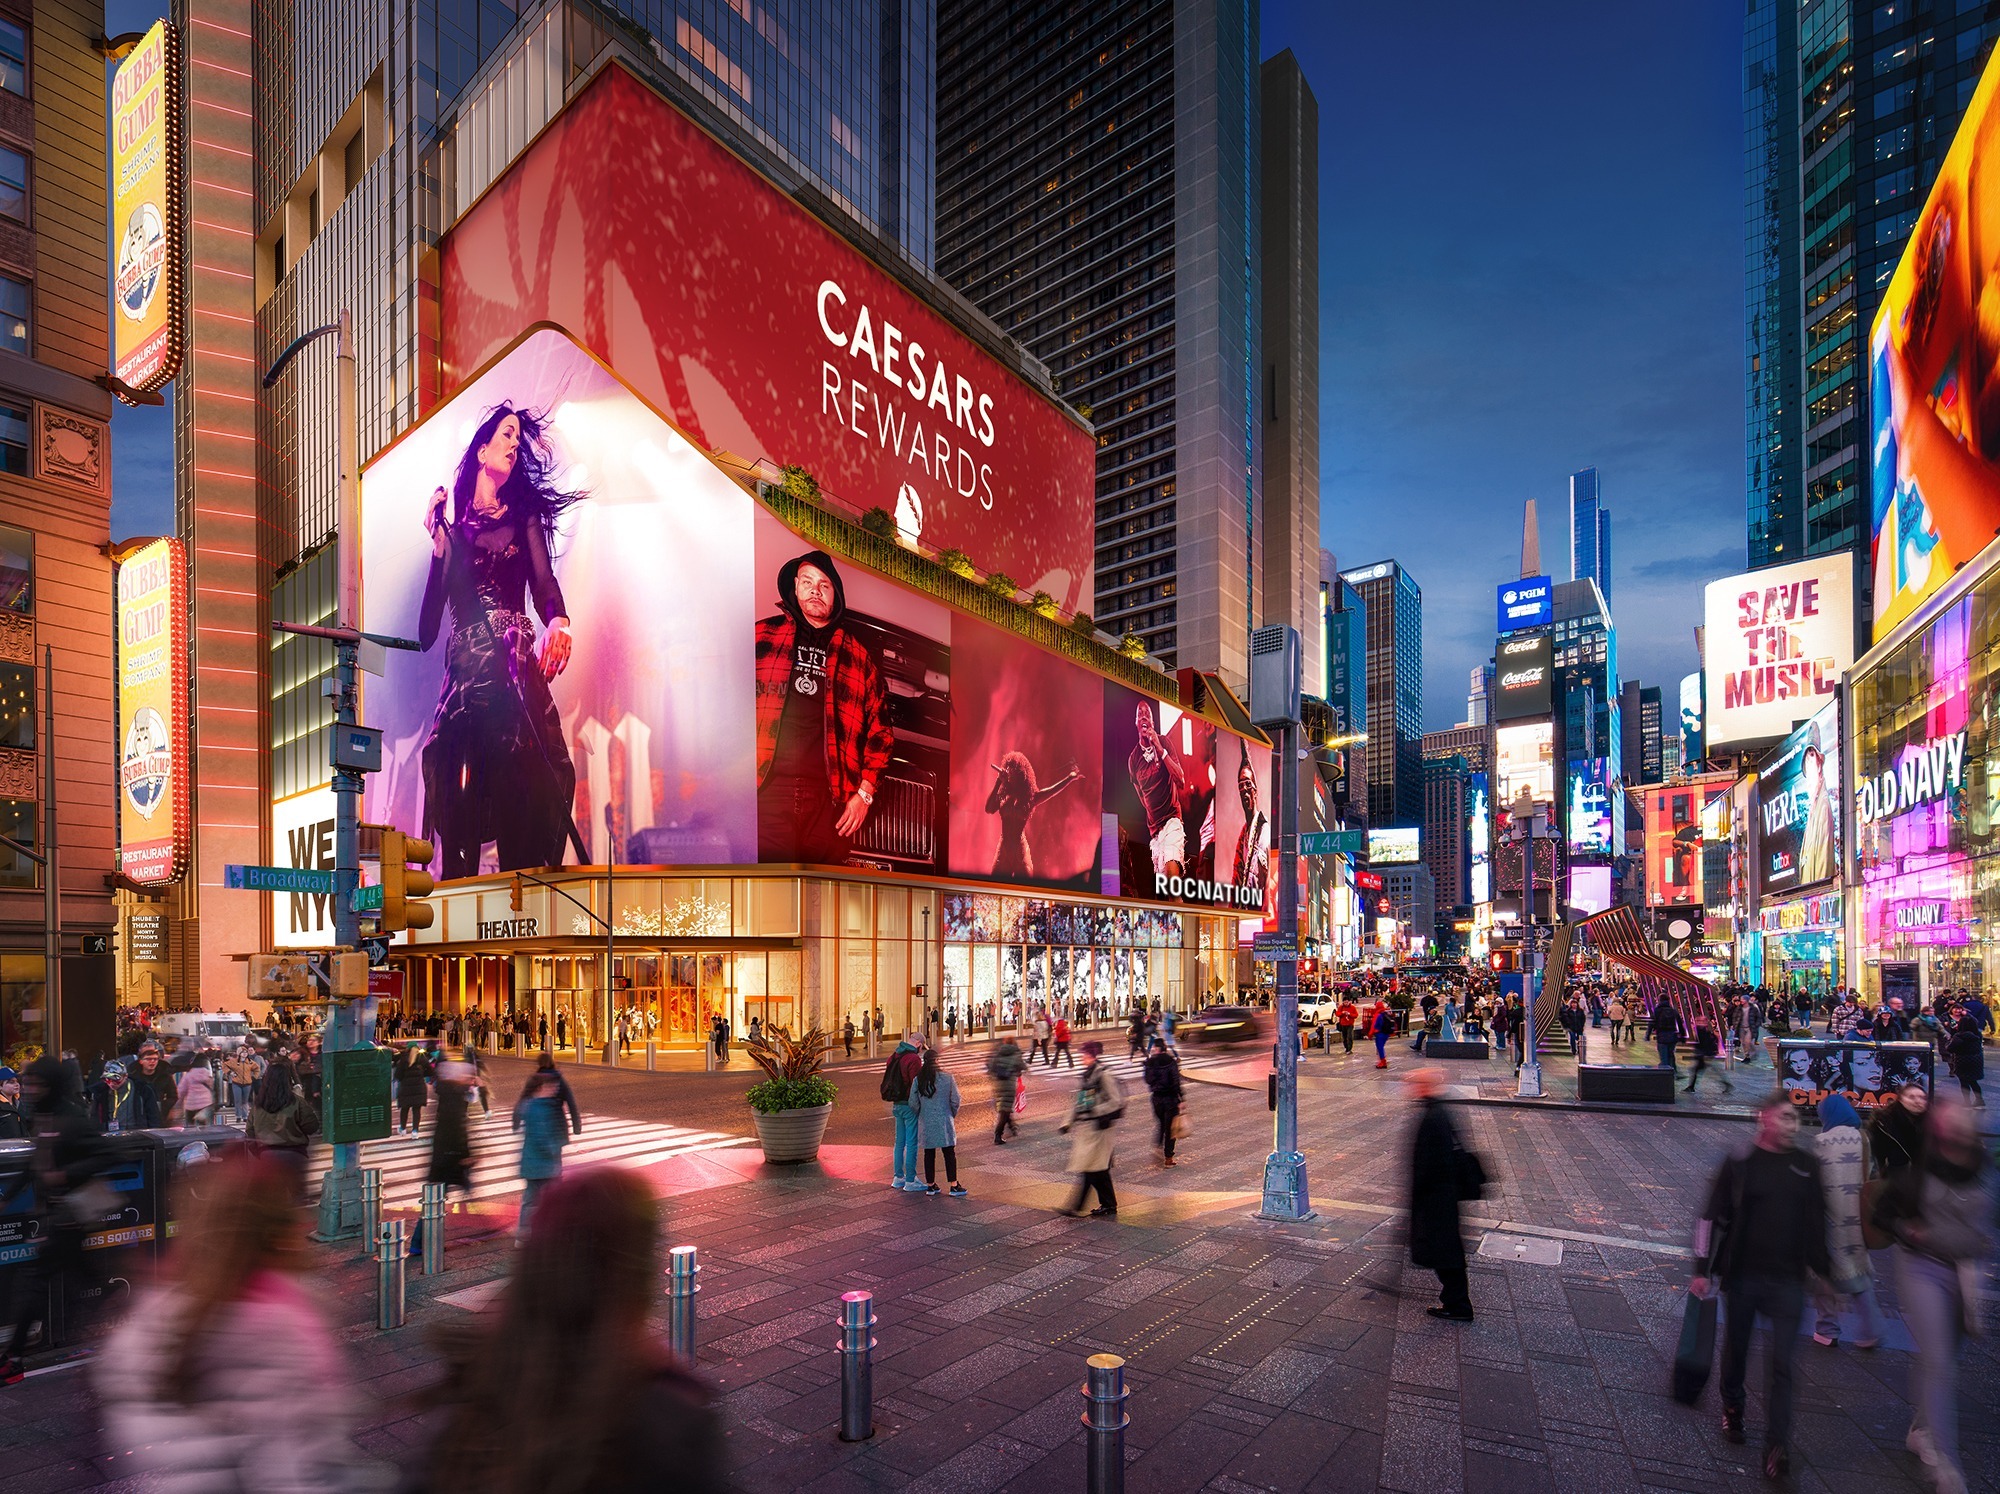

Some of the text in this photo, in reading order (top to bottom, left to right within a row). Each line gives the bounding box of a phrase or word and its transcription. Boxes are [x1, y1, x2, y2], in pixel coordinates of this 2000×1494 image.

[114, 37, 163, 115] BUBBA
[118, 87, 160, 153] GUMP
[118, 147, 161, 198] COMPANY
[122, 136, 157, 178] SHRIMP
[117, 243, 164, 297] BUBBA GUMP
[117, 332, 167, 378] RESTAURANT
[817, 280, 995, 447] CAESARS
[126, 357, 159, 388] MARKET
[823, 361, 993, 511] REWARDS
[120, 554, 168, 603] BUBBA
[1344, 570, 1372, 582] llianz
[1519, 586, 1546, 600] PGIM
[1738, 578, 1819, 629] SAVE
[124, 602, 165, 646] GUMP
[1333, 623, 1345, 694] TIMES
[1504, 638, 1540, 654] Coca-Cola
[1744, 620, 1804, 666] THE
[124, 662, 167, 687] COMPANY
[127, 648, 162, 671] SHRIMP
[1502, 667, 1544, 685] Coca-Cola
[1725, 656, 1835, 709] MUSIC
[123, 754, 170, 784] BUBBA GUMP
[1861, 732, 1966, 824] OLD NAVY
[1764, 785, 1800, 836] VERA
[123, 845, 173, 863] RESTAURANT
[288, 818, 336, 870] WE
[1304, 833, 1358, 852] W 44 ST
[131, 865, 164, 878] MARKET
[1772, 851, 1791, 871] britbox
[250, 869, 329, 894] Broadway
[1155, 873, 1263, 906] ROCNATION
[361, 890, 366, 908] W
[367, 889, 376, 906] 44
[477, 918, 538, 939] THEATER
[1781, 903, 1805, 928] GIFTS
[1897, 904, 1939, 927] OLD NAVY
[107, 1228, 153, 1243] SQUARE
